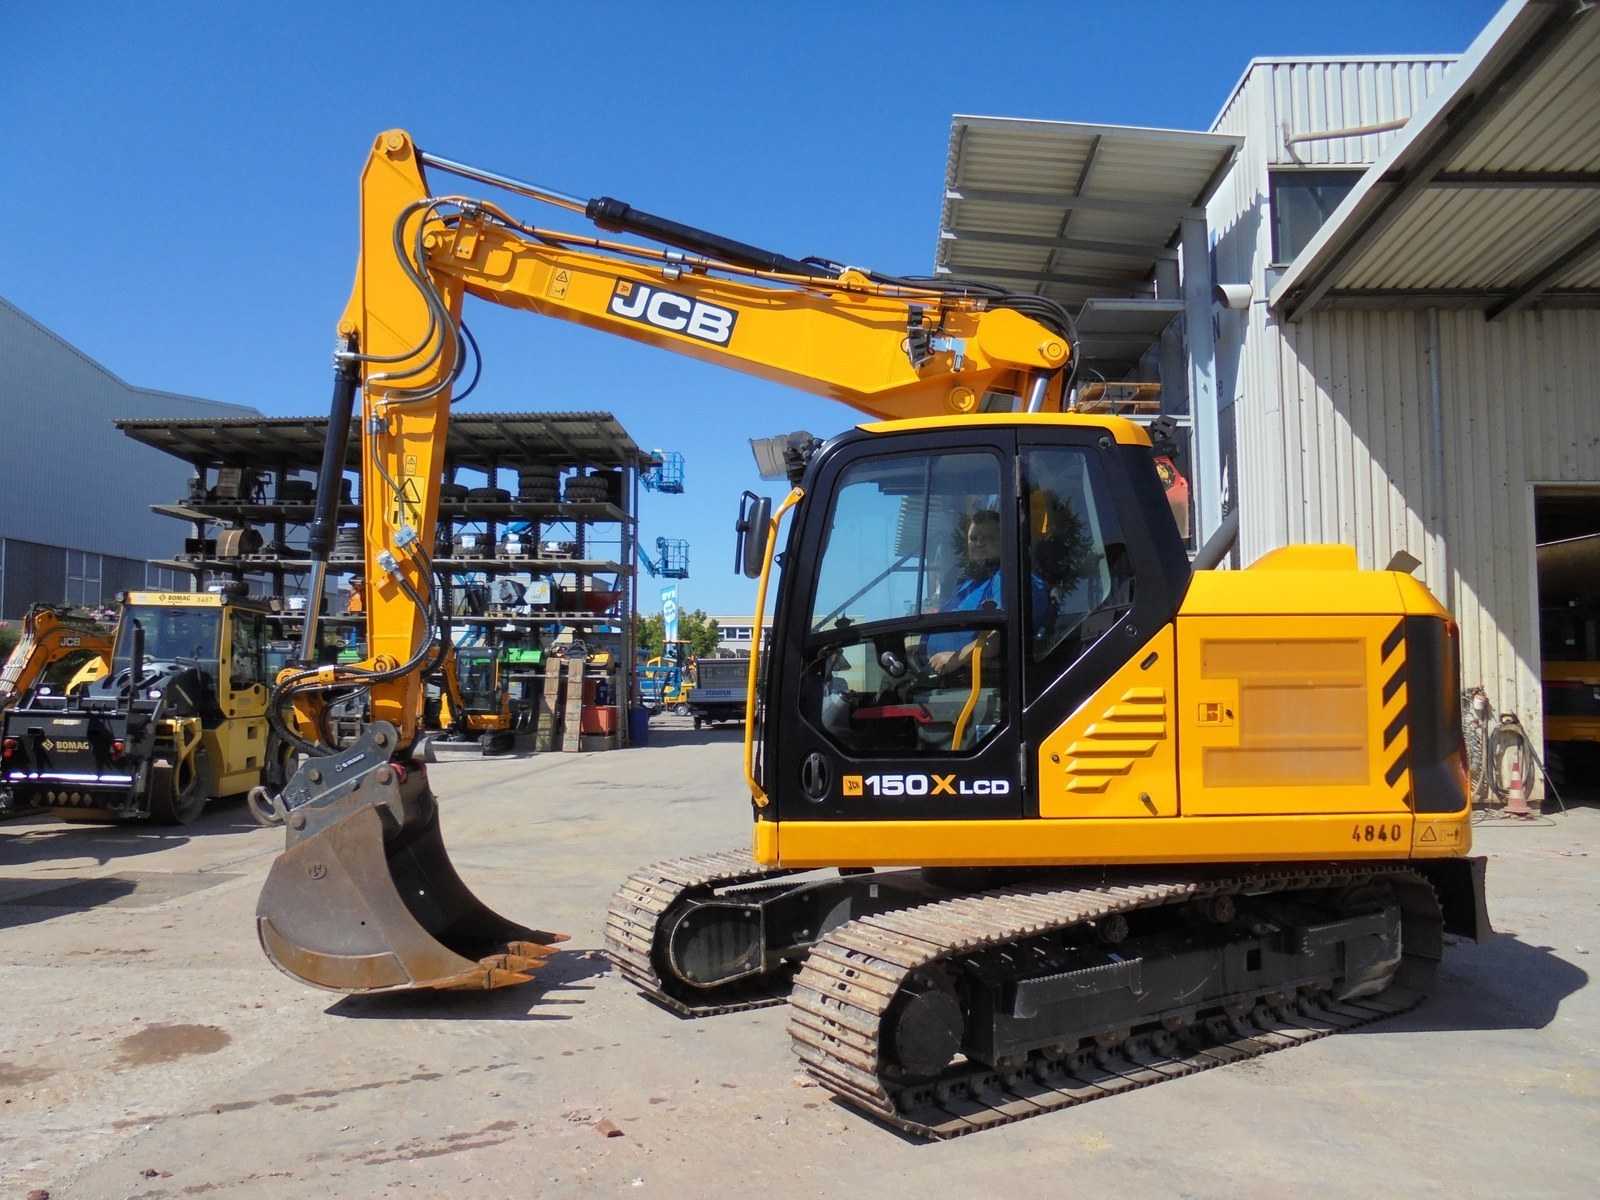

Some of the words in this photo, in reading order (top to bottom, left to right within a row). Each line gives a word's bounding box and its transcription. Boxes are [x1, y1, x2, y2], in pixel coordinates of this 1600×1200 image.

[611, 286, 733, 342] JCB
[60, 637, 81, 646] JCB
[56, 741, 89, 749] BOMAG
[1352, 824, 1401, 842] 4840
